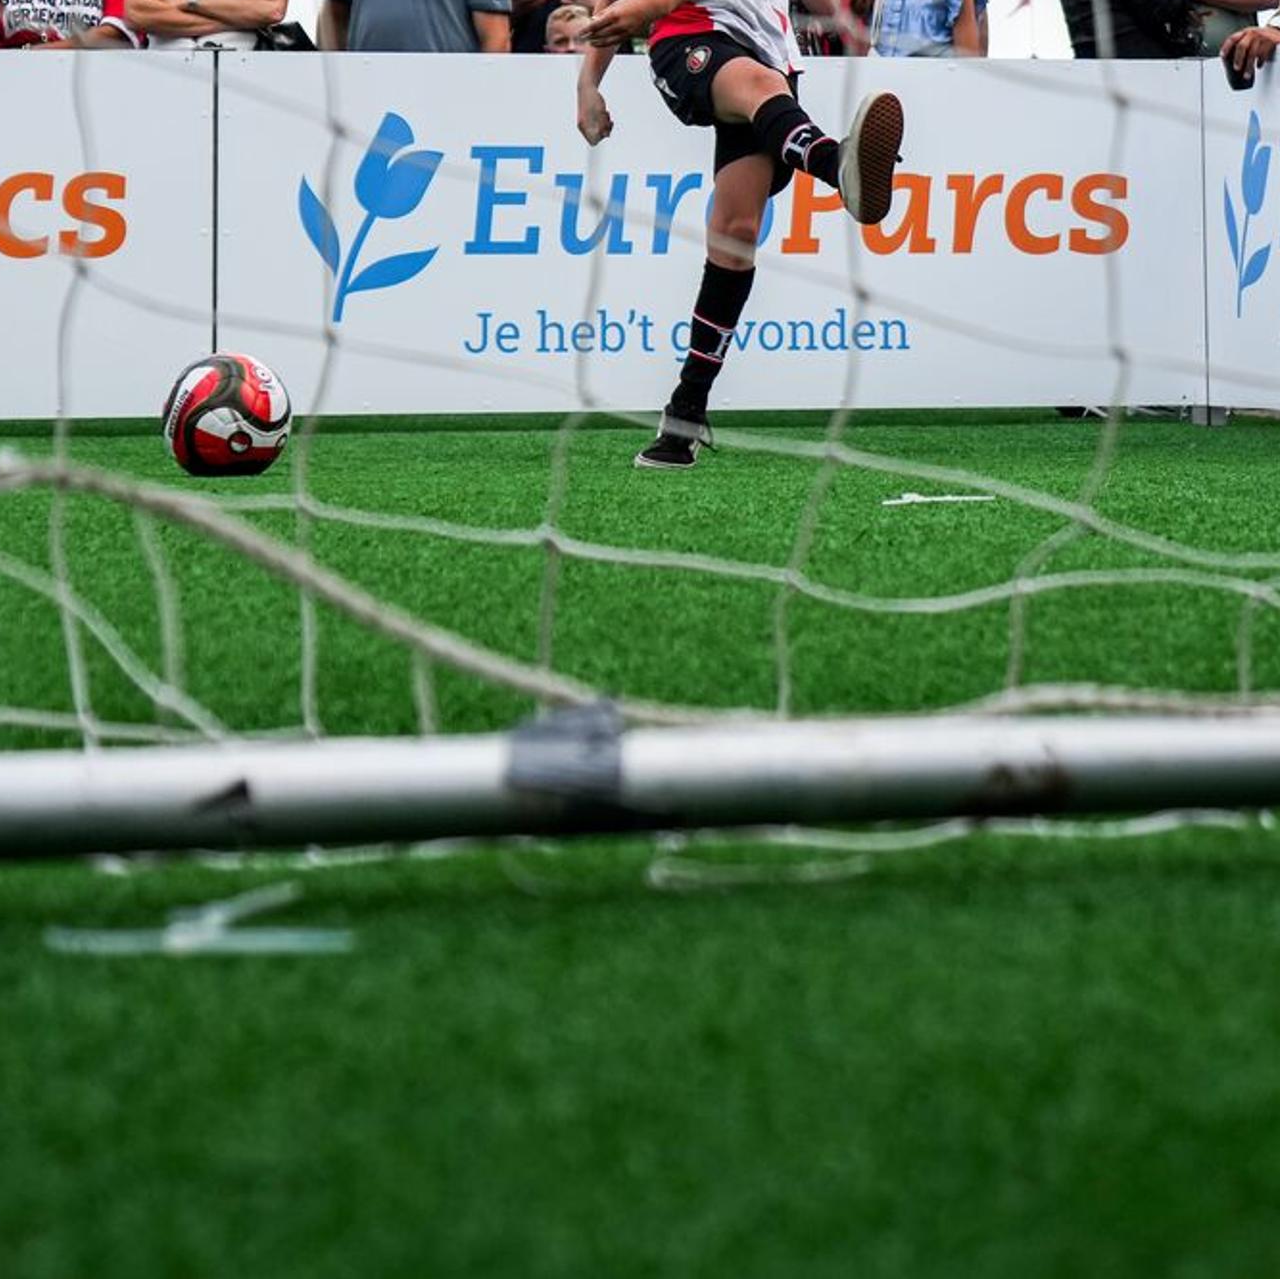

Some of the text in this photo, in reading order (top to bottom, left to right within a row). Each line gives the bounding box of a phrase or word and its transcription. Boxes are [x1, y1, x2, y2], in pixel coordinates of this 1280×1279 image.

[464, 145, 1130, 257] EurParcs
[464, 308, 911, 364] Je heb't gvonden
